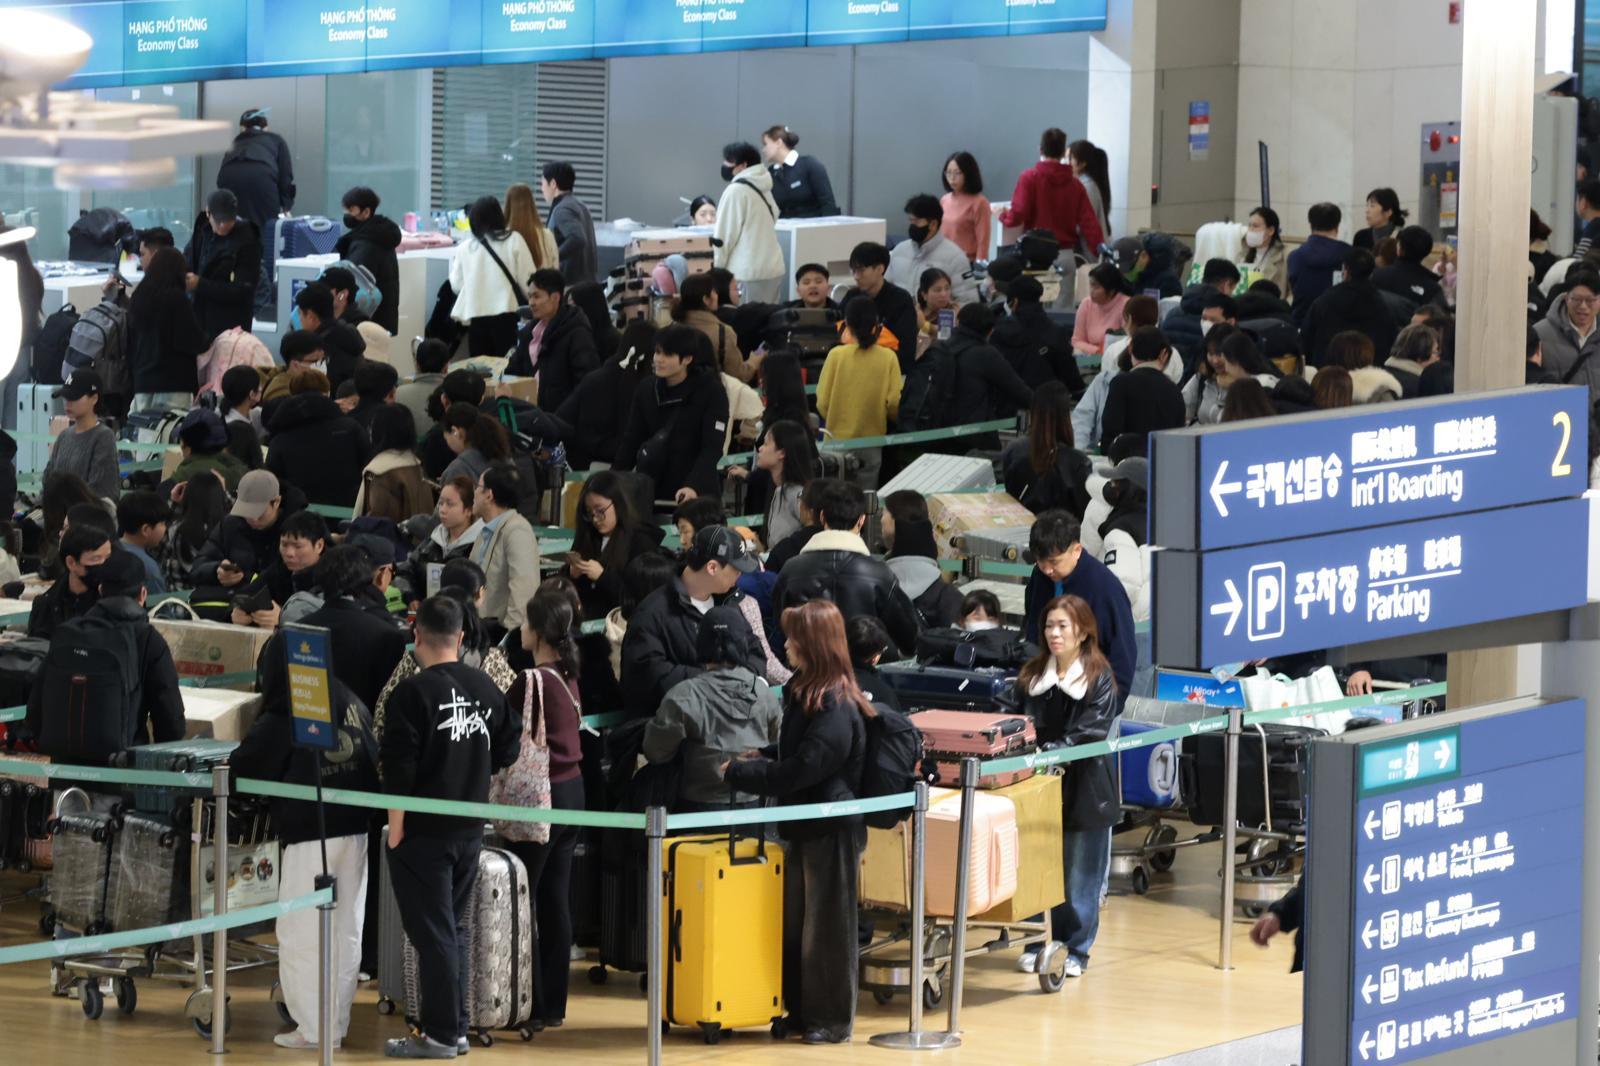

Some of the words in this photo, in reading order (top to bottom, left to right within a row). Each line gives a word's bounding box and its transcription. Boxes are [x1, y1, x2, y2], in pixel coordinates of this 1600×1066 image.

[320, 10, 346, 27] HẠNG
[683, 10, 718, 24] Economy
[718, 8, 737, 20] Class
[848, 2, 880, 16] Economy
[881, 0, 899, 13] Class
[128, 20, 155, 37] HẠNG
[176, 16, 208, 32] THÔNG
[328, 28, 366, 43] Economy
[366, 26, 389, 39] Class
[510, 19, 546, 33] Economy
[546, 17, 567, 30] Class
[137, 38, 176, 53] Economy
[177, 36, 199, 49] Class
[1550, 411, 1572, 478] 2
[1245, 452, 1343, 508] 국제선탑승
[1388, 464, 1463, 502] Boarding
[1257, 576, 1279, 631] P
[1294, 564, 1360, 620] 주차장
[1367, 584, 1431, 623] Parking
[1402, 965, 1424, 991] Tax
[1424, 952, 1469, 987] Refund
